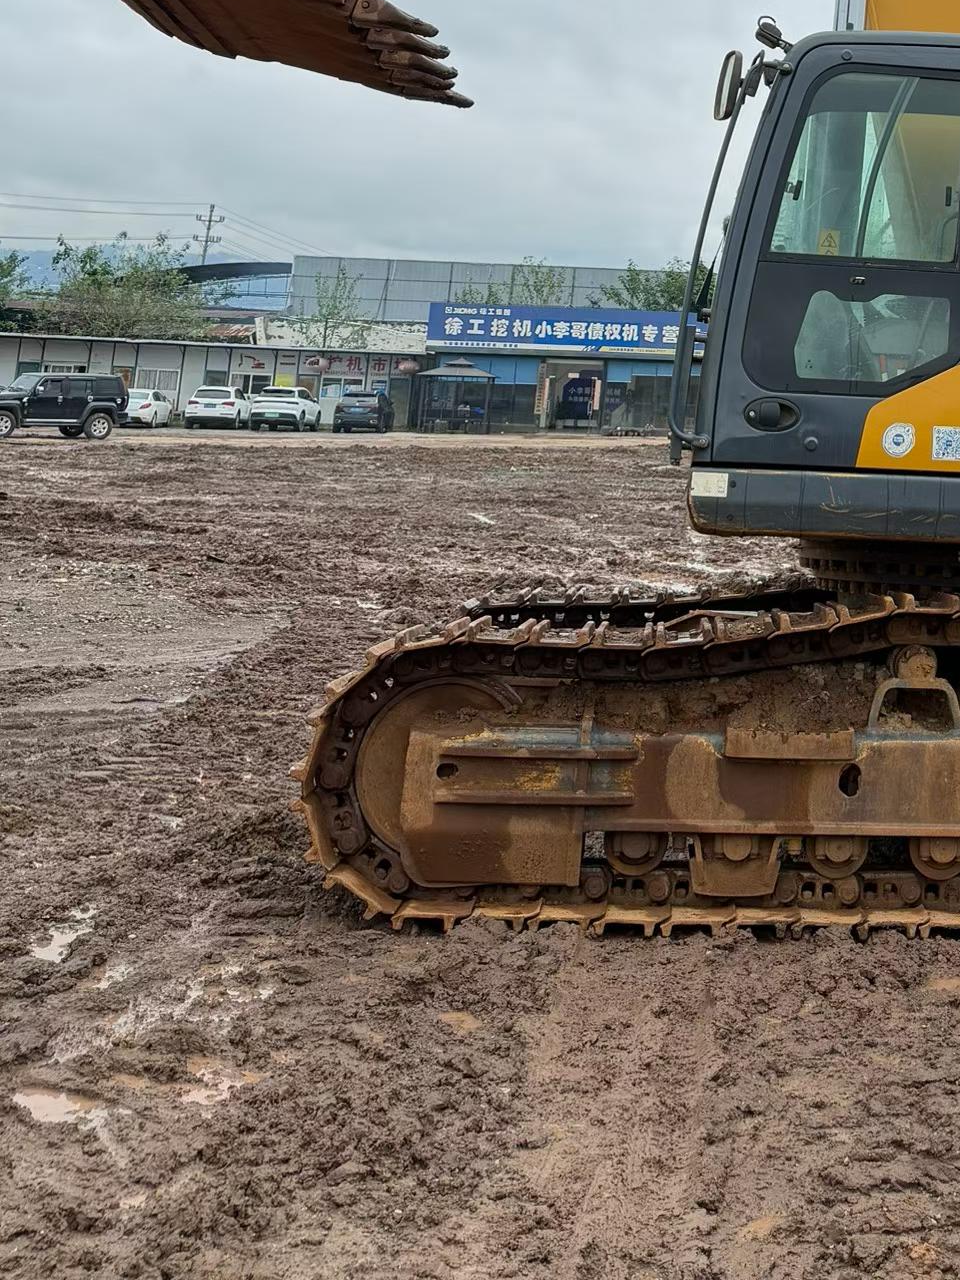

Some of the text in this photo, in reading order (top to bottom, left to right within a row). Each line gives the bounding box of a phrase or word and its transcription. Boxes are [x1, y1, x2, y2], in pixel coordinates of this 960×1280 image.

[444, 316, 704, 344] 徐工挖机小李哥债权机专营
